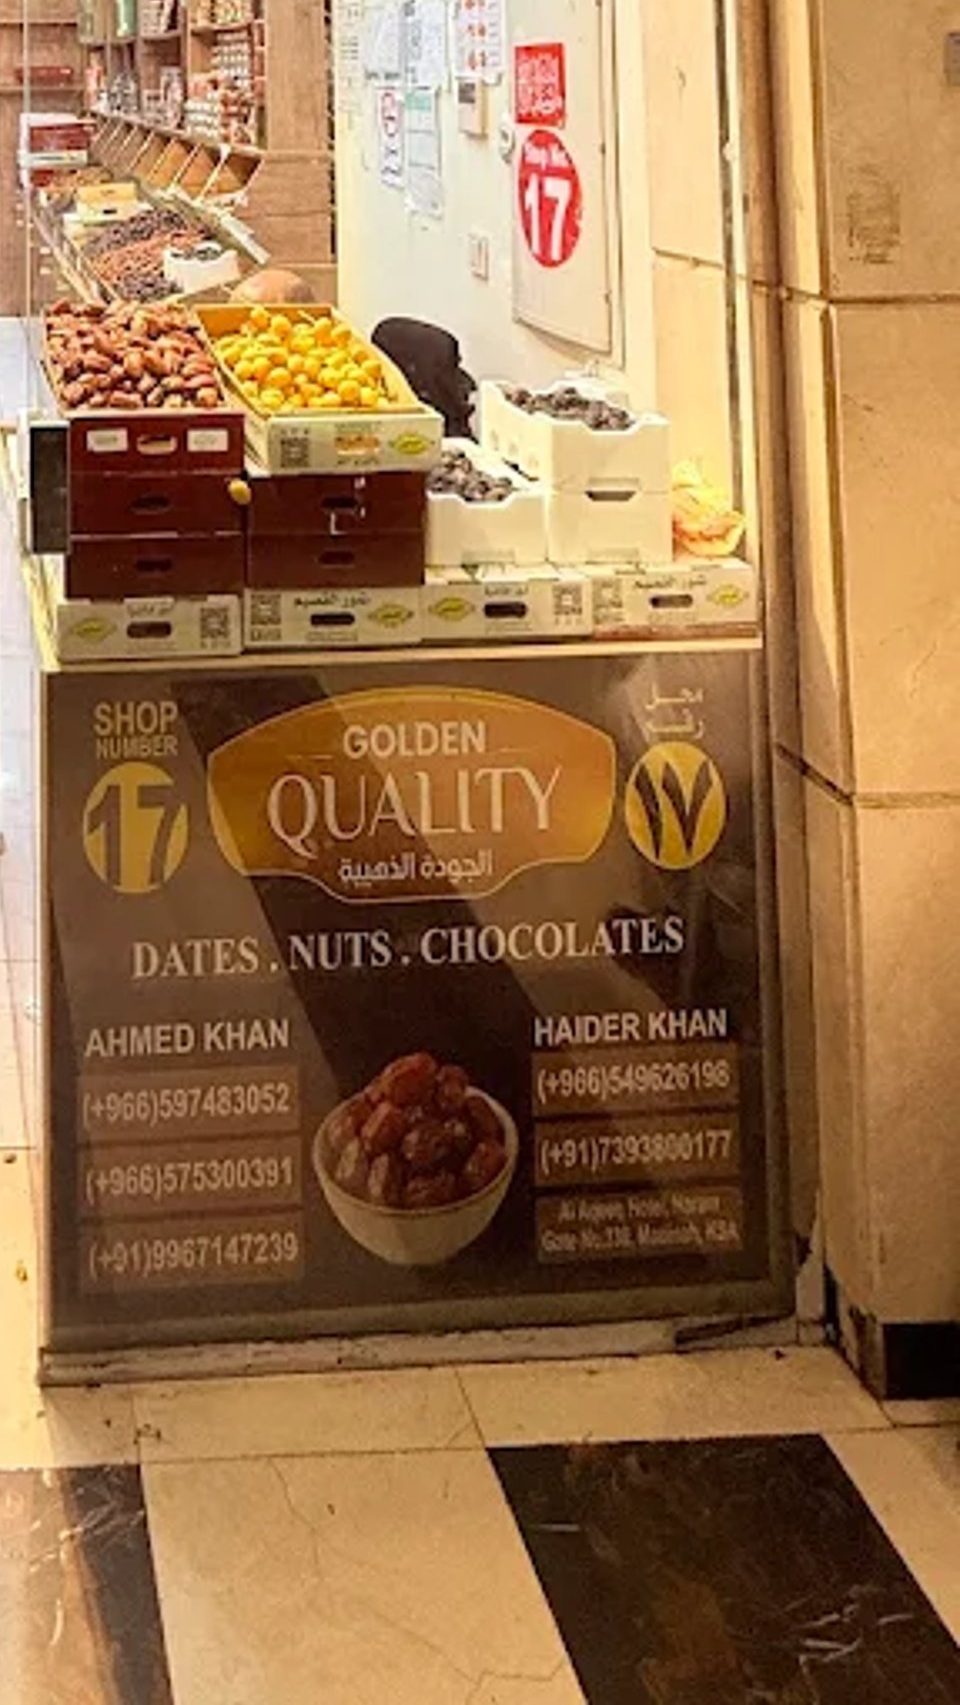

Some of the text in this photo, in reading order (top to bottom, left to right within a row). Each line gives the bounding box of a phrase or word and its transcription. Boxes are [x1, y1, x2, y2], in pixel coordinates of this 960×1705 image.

[524, 172, 573, 262] 17
[93, 700, 179, 736] SHOP
[343, 720, 486, 760] GOLDEN
[96, 734, 179, 761] NUMBER
[87, 782, 182, 888] 17
[267, 764, 563, 860] QUALITY
[338, 848, 493, 888] الجودة الذهبية
[132, 936, 259, 979] DATES
[288, 930, 392, 971] NUTS
[420, 914, 686, 965] CHOCOLATES
[84, 1018, 290, 1058] AHMED KHAN
[534, 1008, 728, 1047] HAIDER KHAN
[82, 1081, 290, 1132] (+966)597483052
[86, 1155, 293, 1206] (+966)575300391
[89, 1231, 299, 1281] (+91)9967147239
